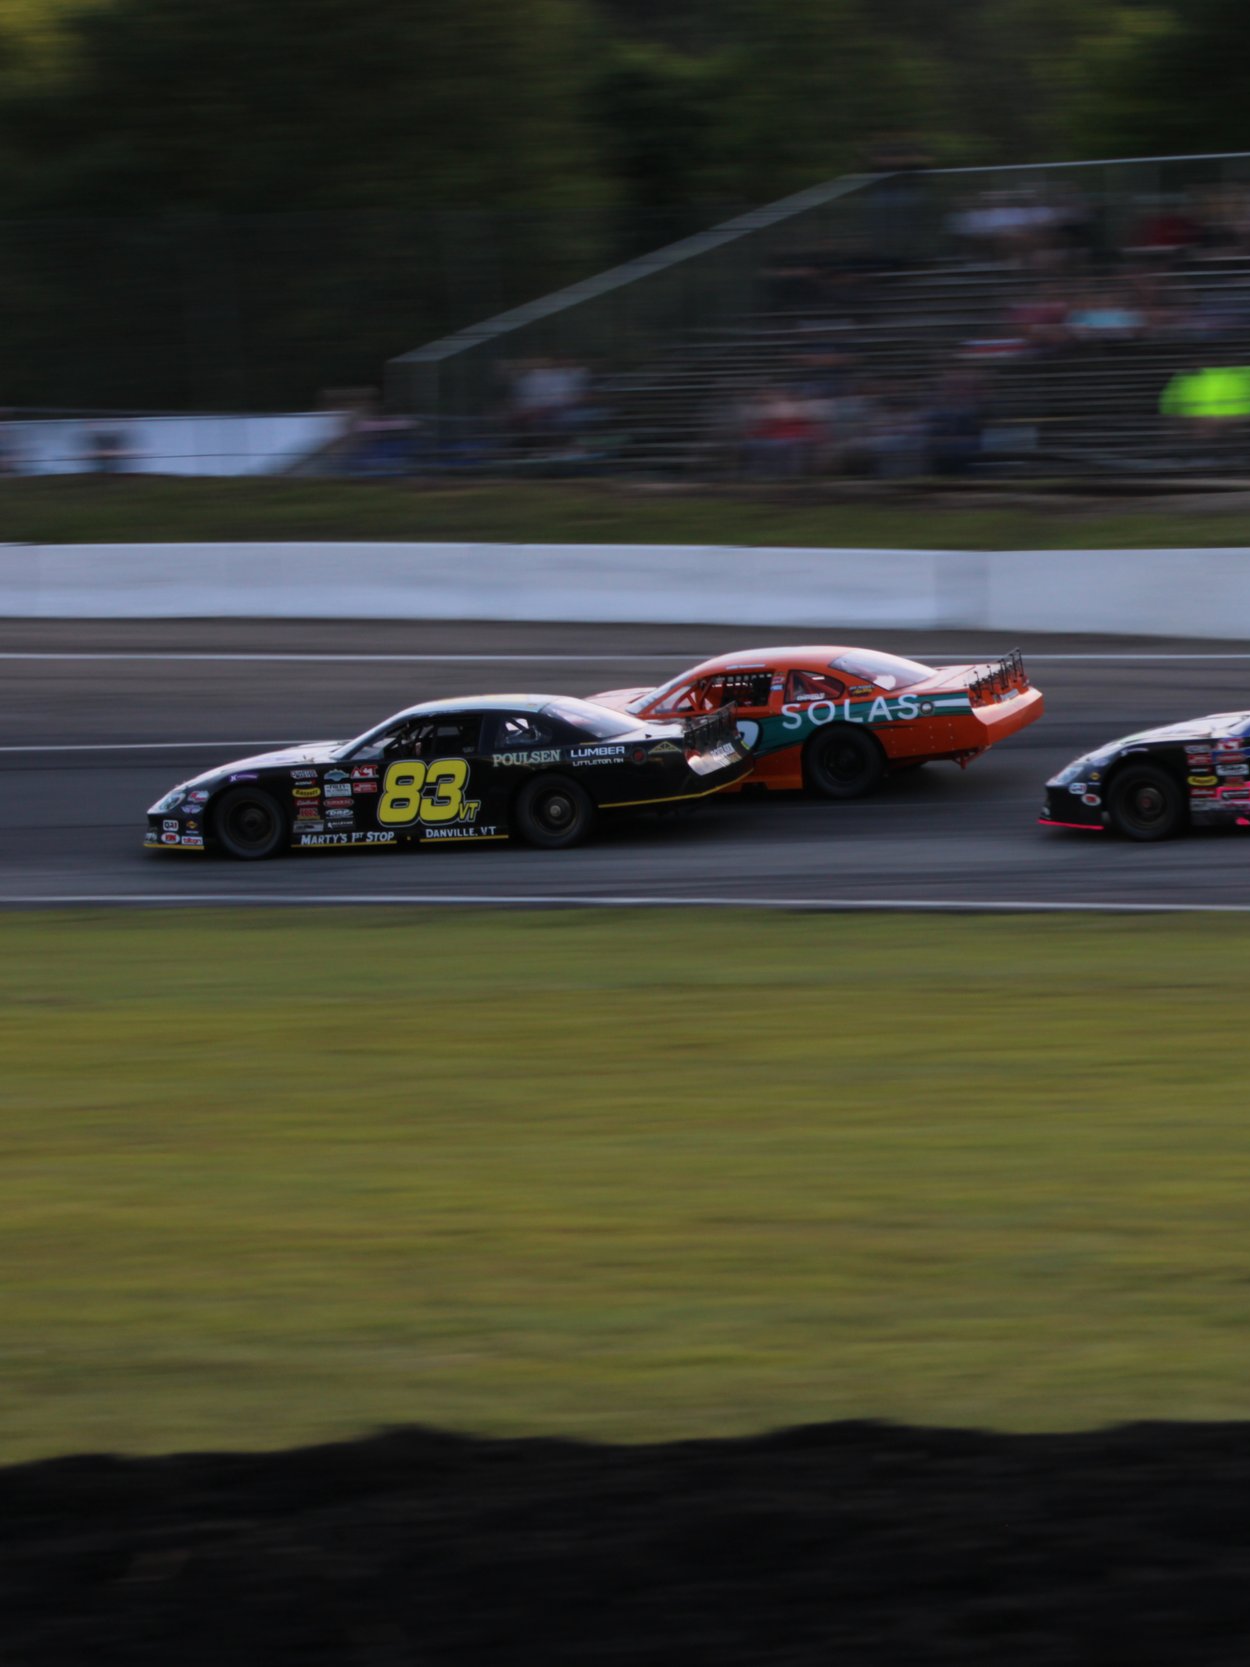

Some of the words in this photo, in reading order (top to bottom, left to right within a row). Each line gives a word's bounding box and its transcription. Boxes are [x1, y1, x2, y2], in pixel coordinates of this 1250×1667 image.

[781, 694, 919, 730] SOLAS
[492, 749, 560, 767] POULSEN
[570, 746, 625, 758] LUMBER
[380, 759, 470, 826] 83
[459, 803, 478, 821] VT
[301, 833, 347, 845] MARTY'S
[366, 831, 394, 842] STOP
[481, 826, 496, 836] VT
